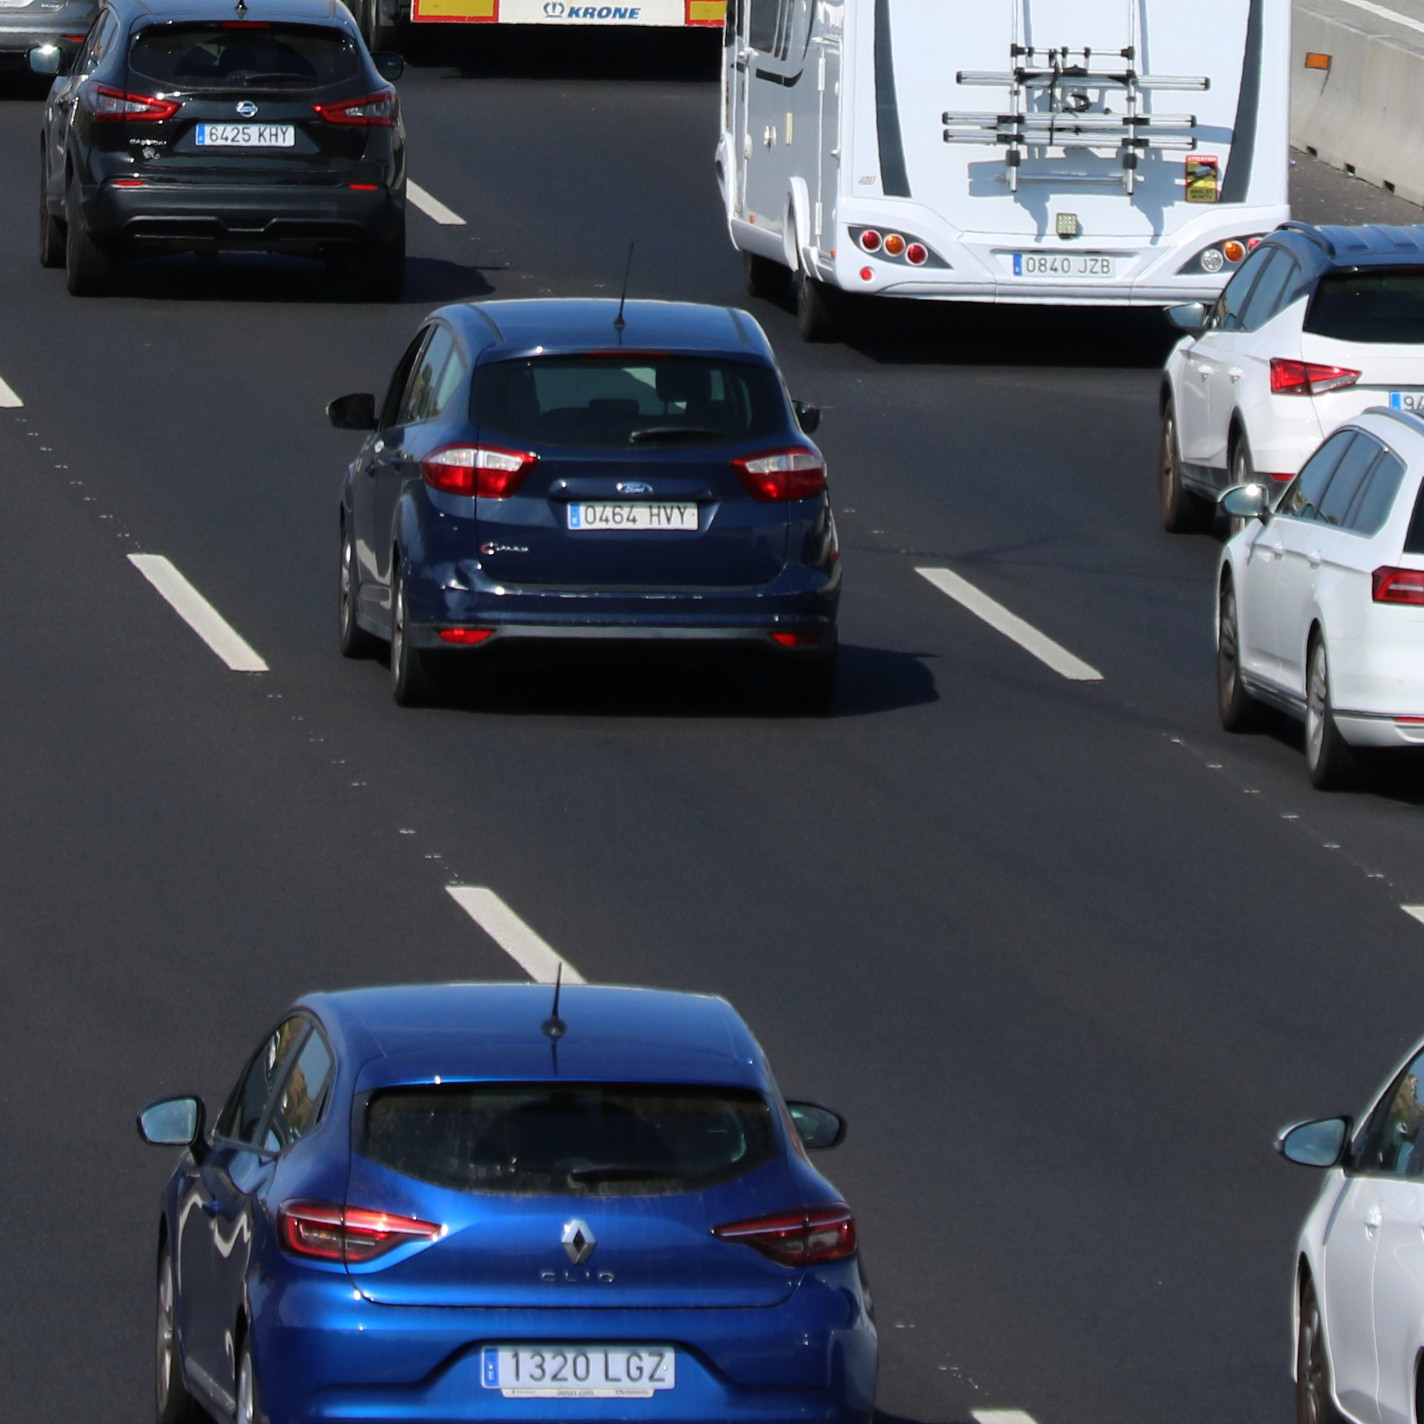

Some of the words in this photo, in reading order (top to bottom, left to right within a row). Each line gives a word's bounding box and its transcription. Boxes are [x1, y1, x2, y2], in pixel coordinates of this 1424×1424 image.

[567, 6, 641, 19] KRONE
[209, 127, 252, 143] 6425
[258, 127, 289, 143] KHY
[1026, 257, 1071, 274] 0840
[1078, 257, 1111, 274] JZB
[584, 507, 638, 526] 0464
[649, 507, 687, 526] HVY
[541, 1271, 615, 1282] CLIO
[511, 1350, 590, 1382] 1320
[604, 1352, 666, 1383] LGZ
